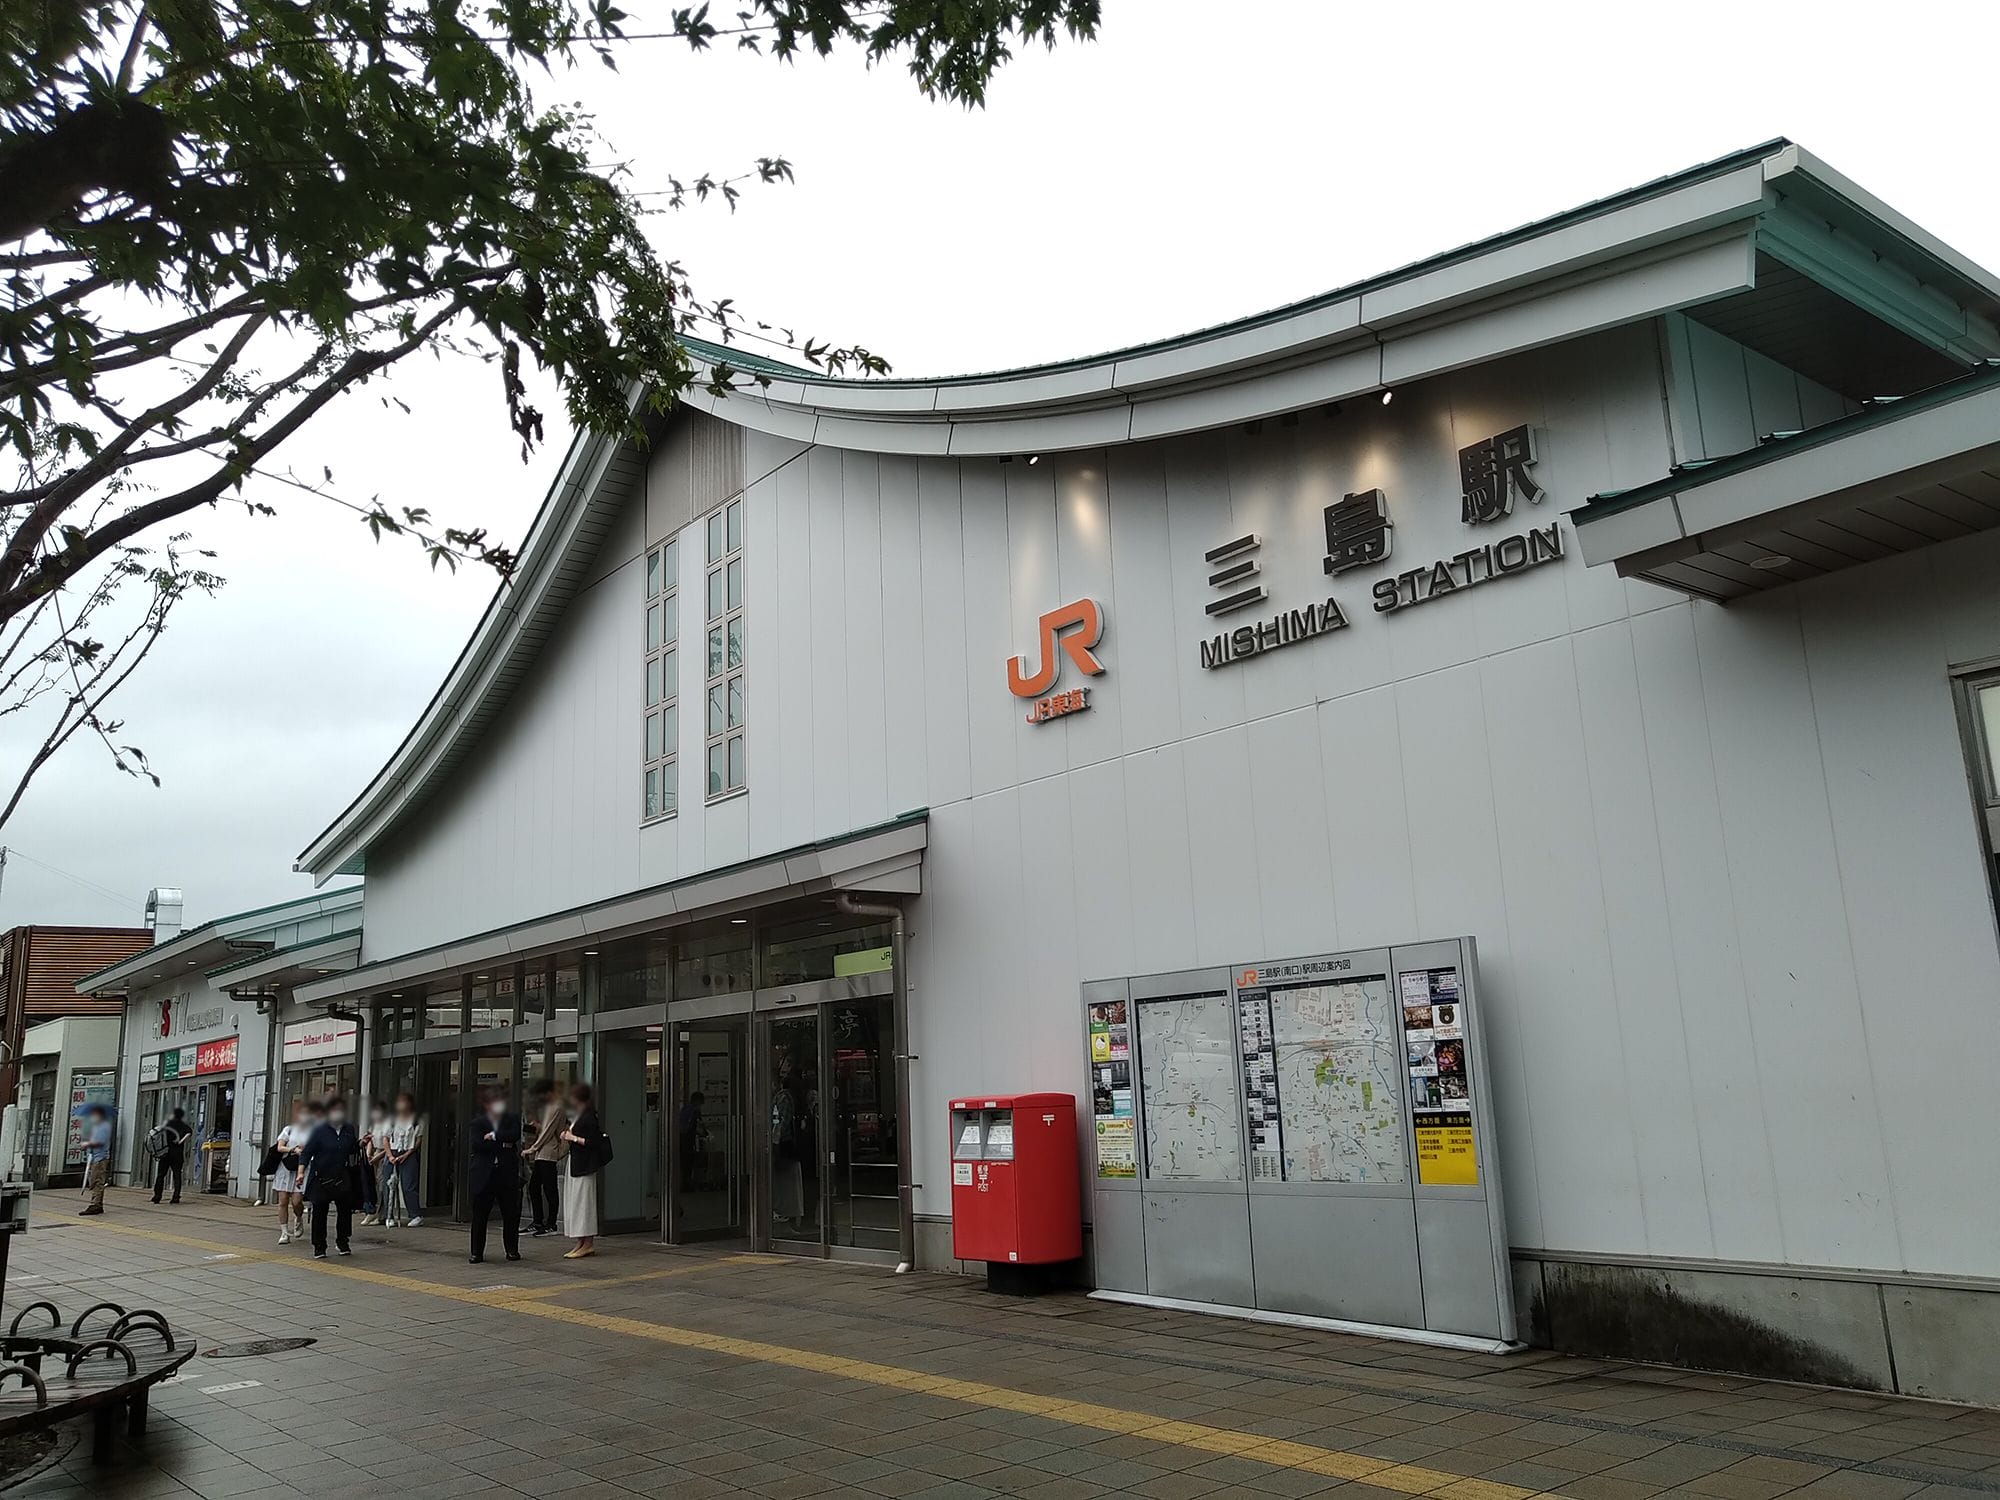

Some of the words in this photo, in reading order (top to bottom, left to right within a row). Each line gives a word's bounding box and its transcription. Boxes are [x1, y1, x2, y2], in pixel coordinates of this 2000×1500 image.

[1205, 423, 1545, 617] 三島駅
[1200, 597, 1350, 670] MISHIMA
[1372, 521, 1565, 614] STATION
[1006, 597, 1105, 699] JR
[1025, 687, 1091, 724] JR東海
[1236, 969, 1257, 987] JR
[1258, 959, 1351, 979] 三島駅(南口)駅周辺案内図
